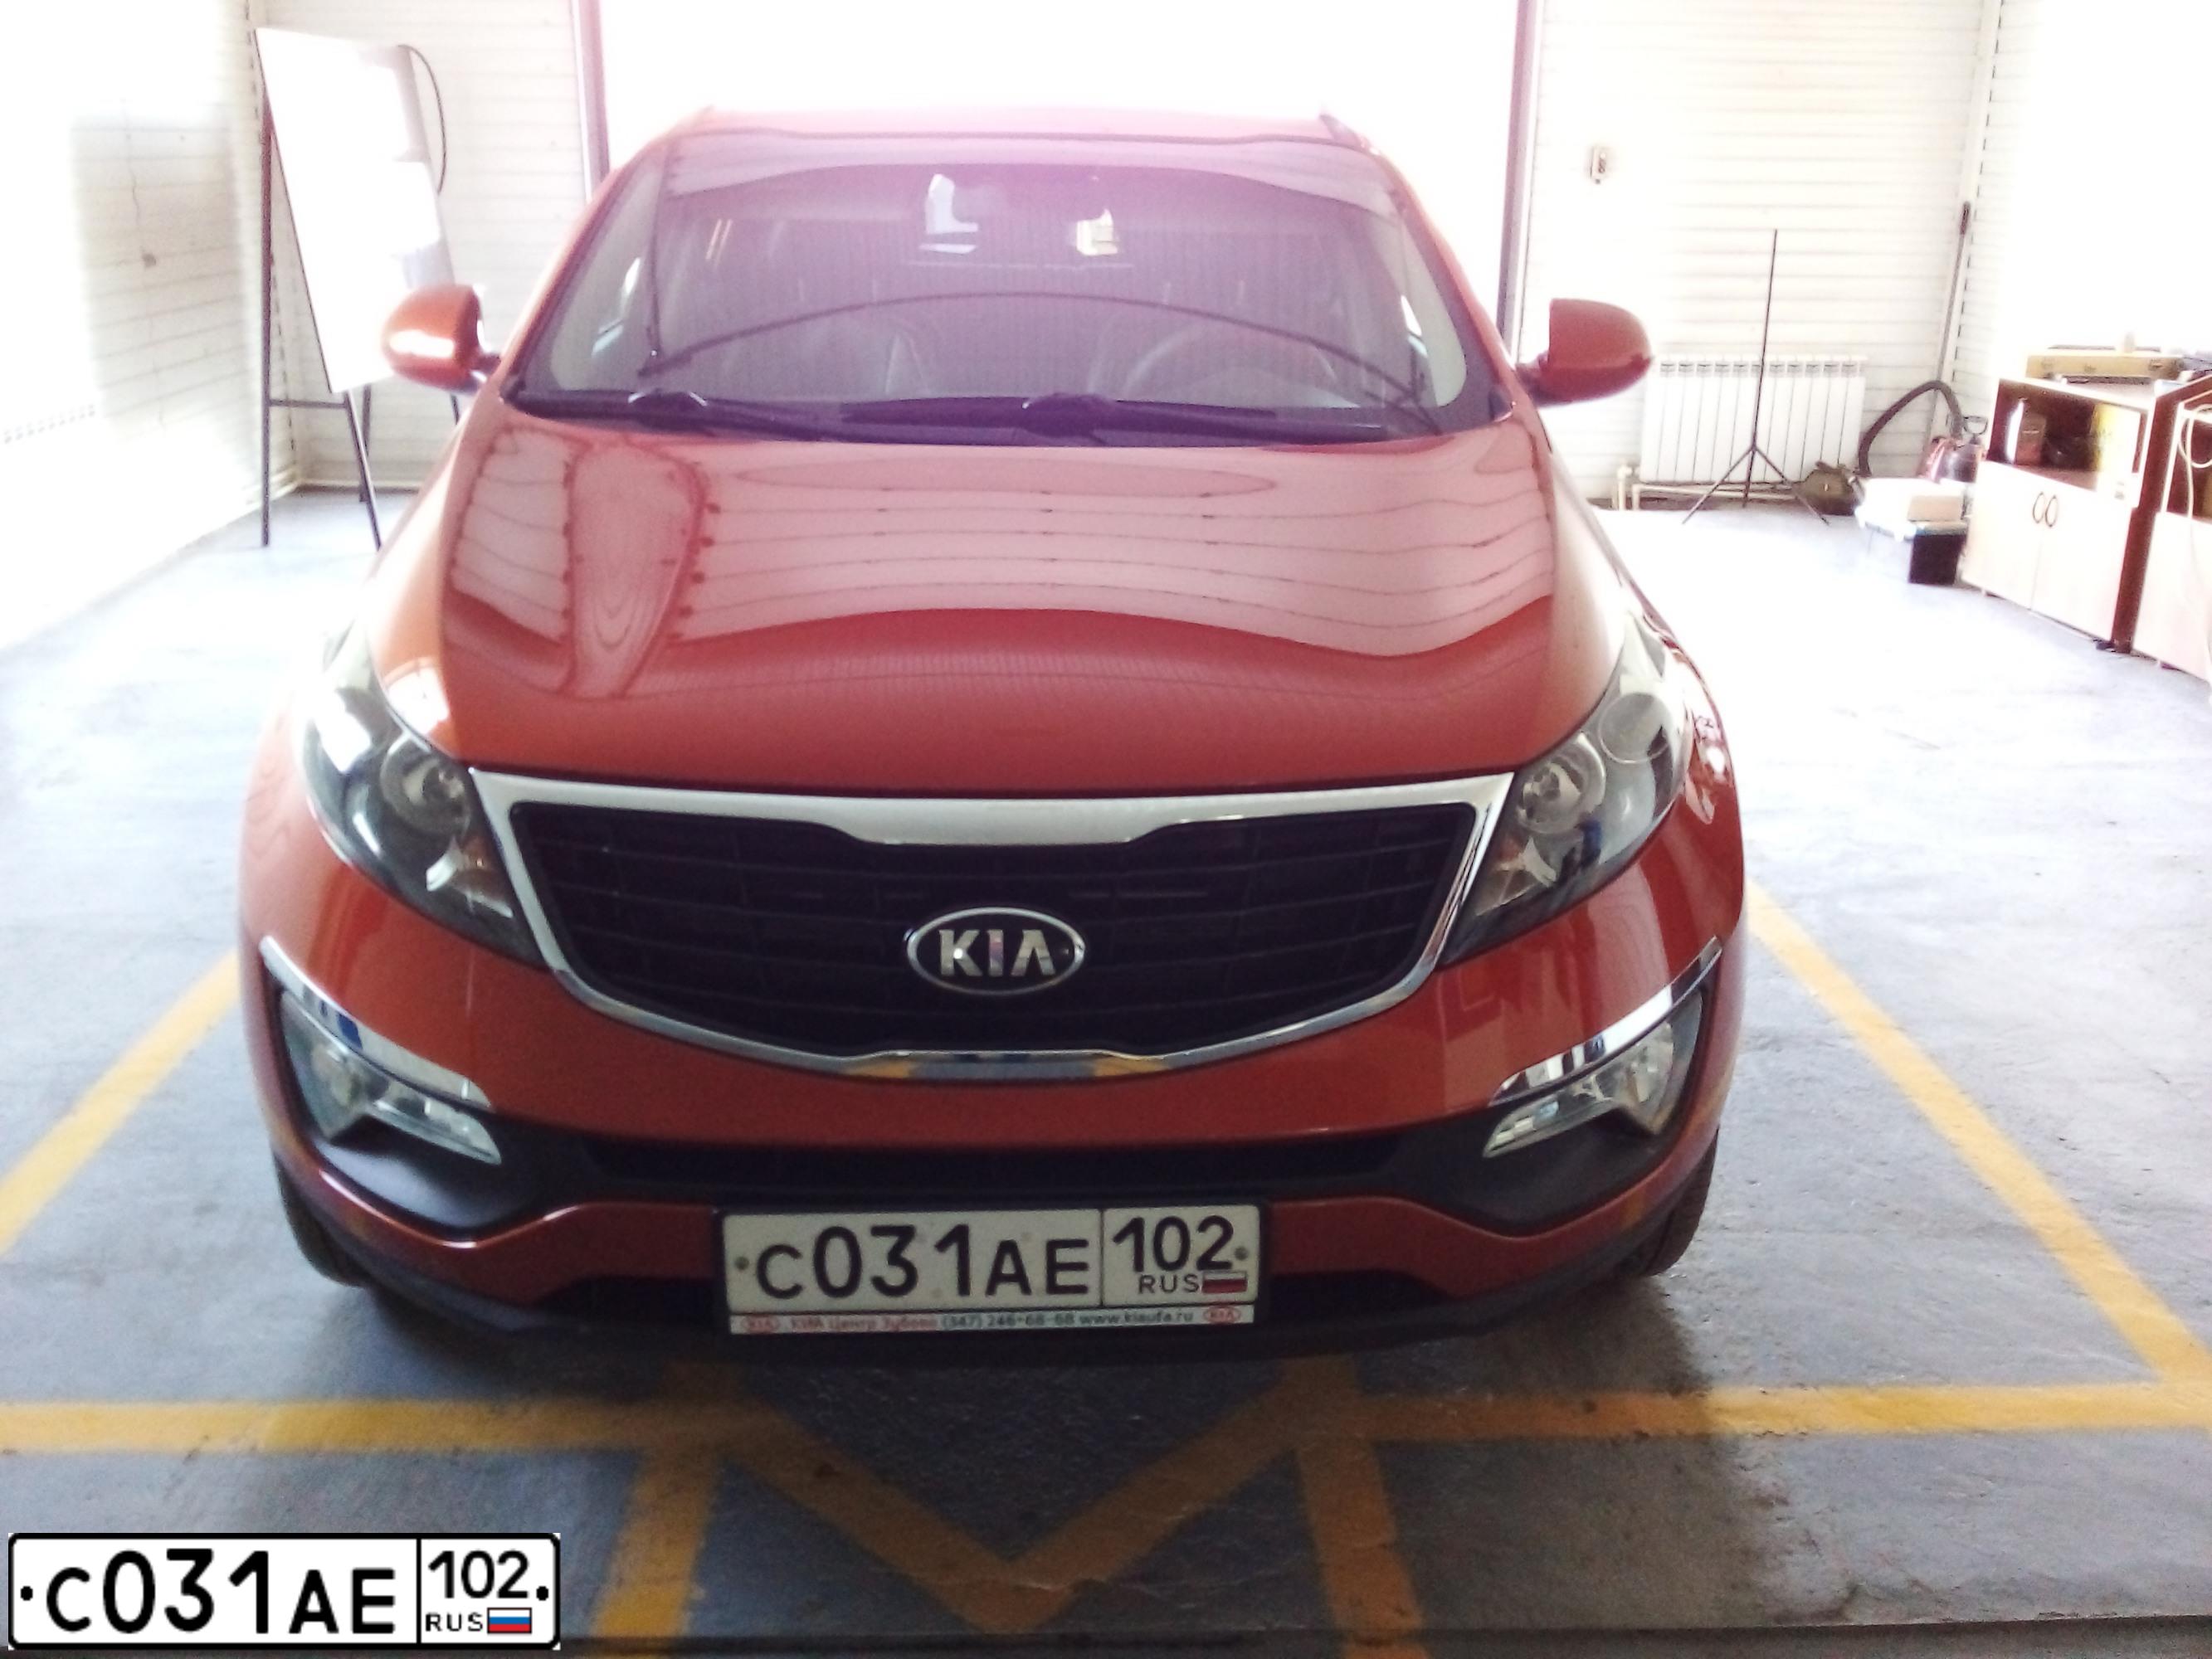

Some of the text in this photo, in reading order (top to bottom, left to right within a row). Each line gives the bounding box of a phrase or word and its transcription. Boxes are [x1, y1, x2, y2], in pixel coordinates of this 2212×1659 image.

[938, 929, 1056, 977] KIA
[1113, 1214, 1235, 1273] 102
[1138, 1273, 1200, 1294] RUS
